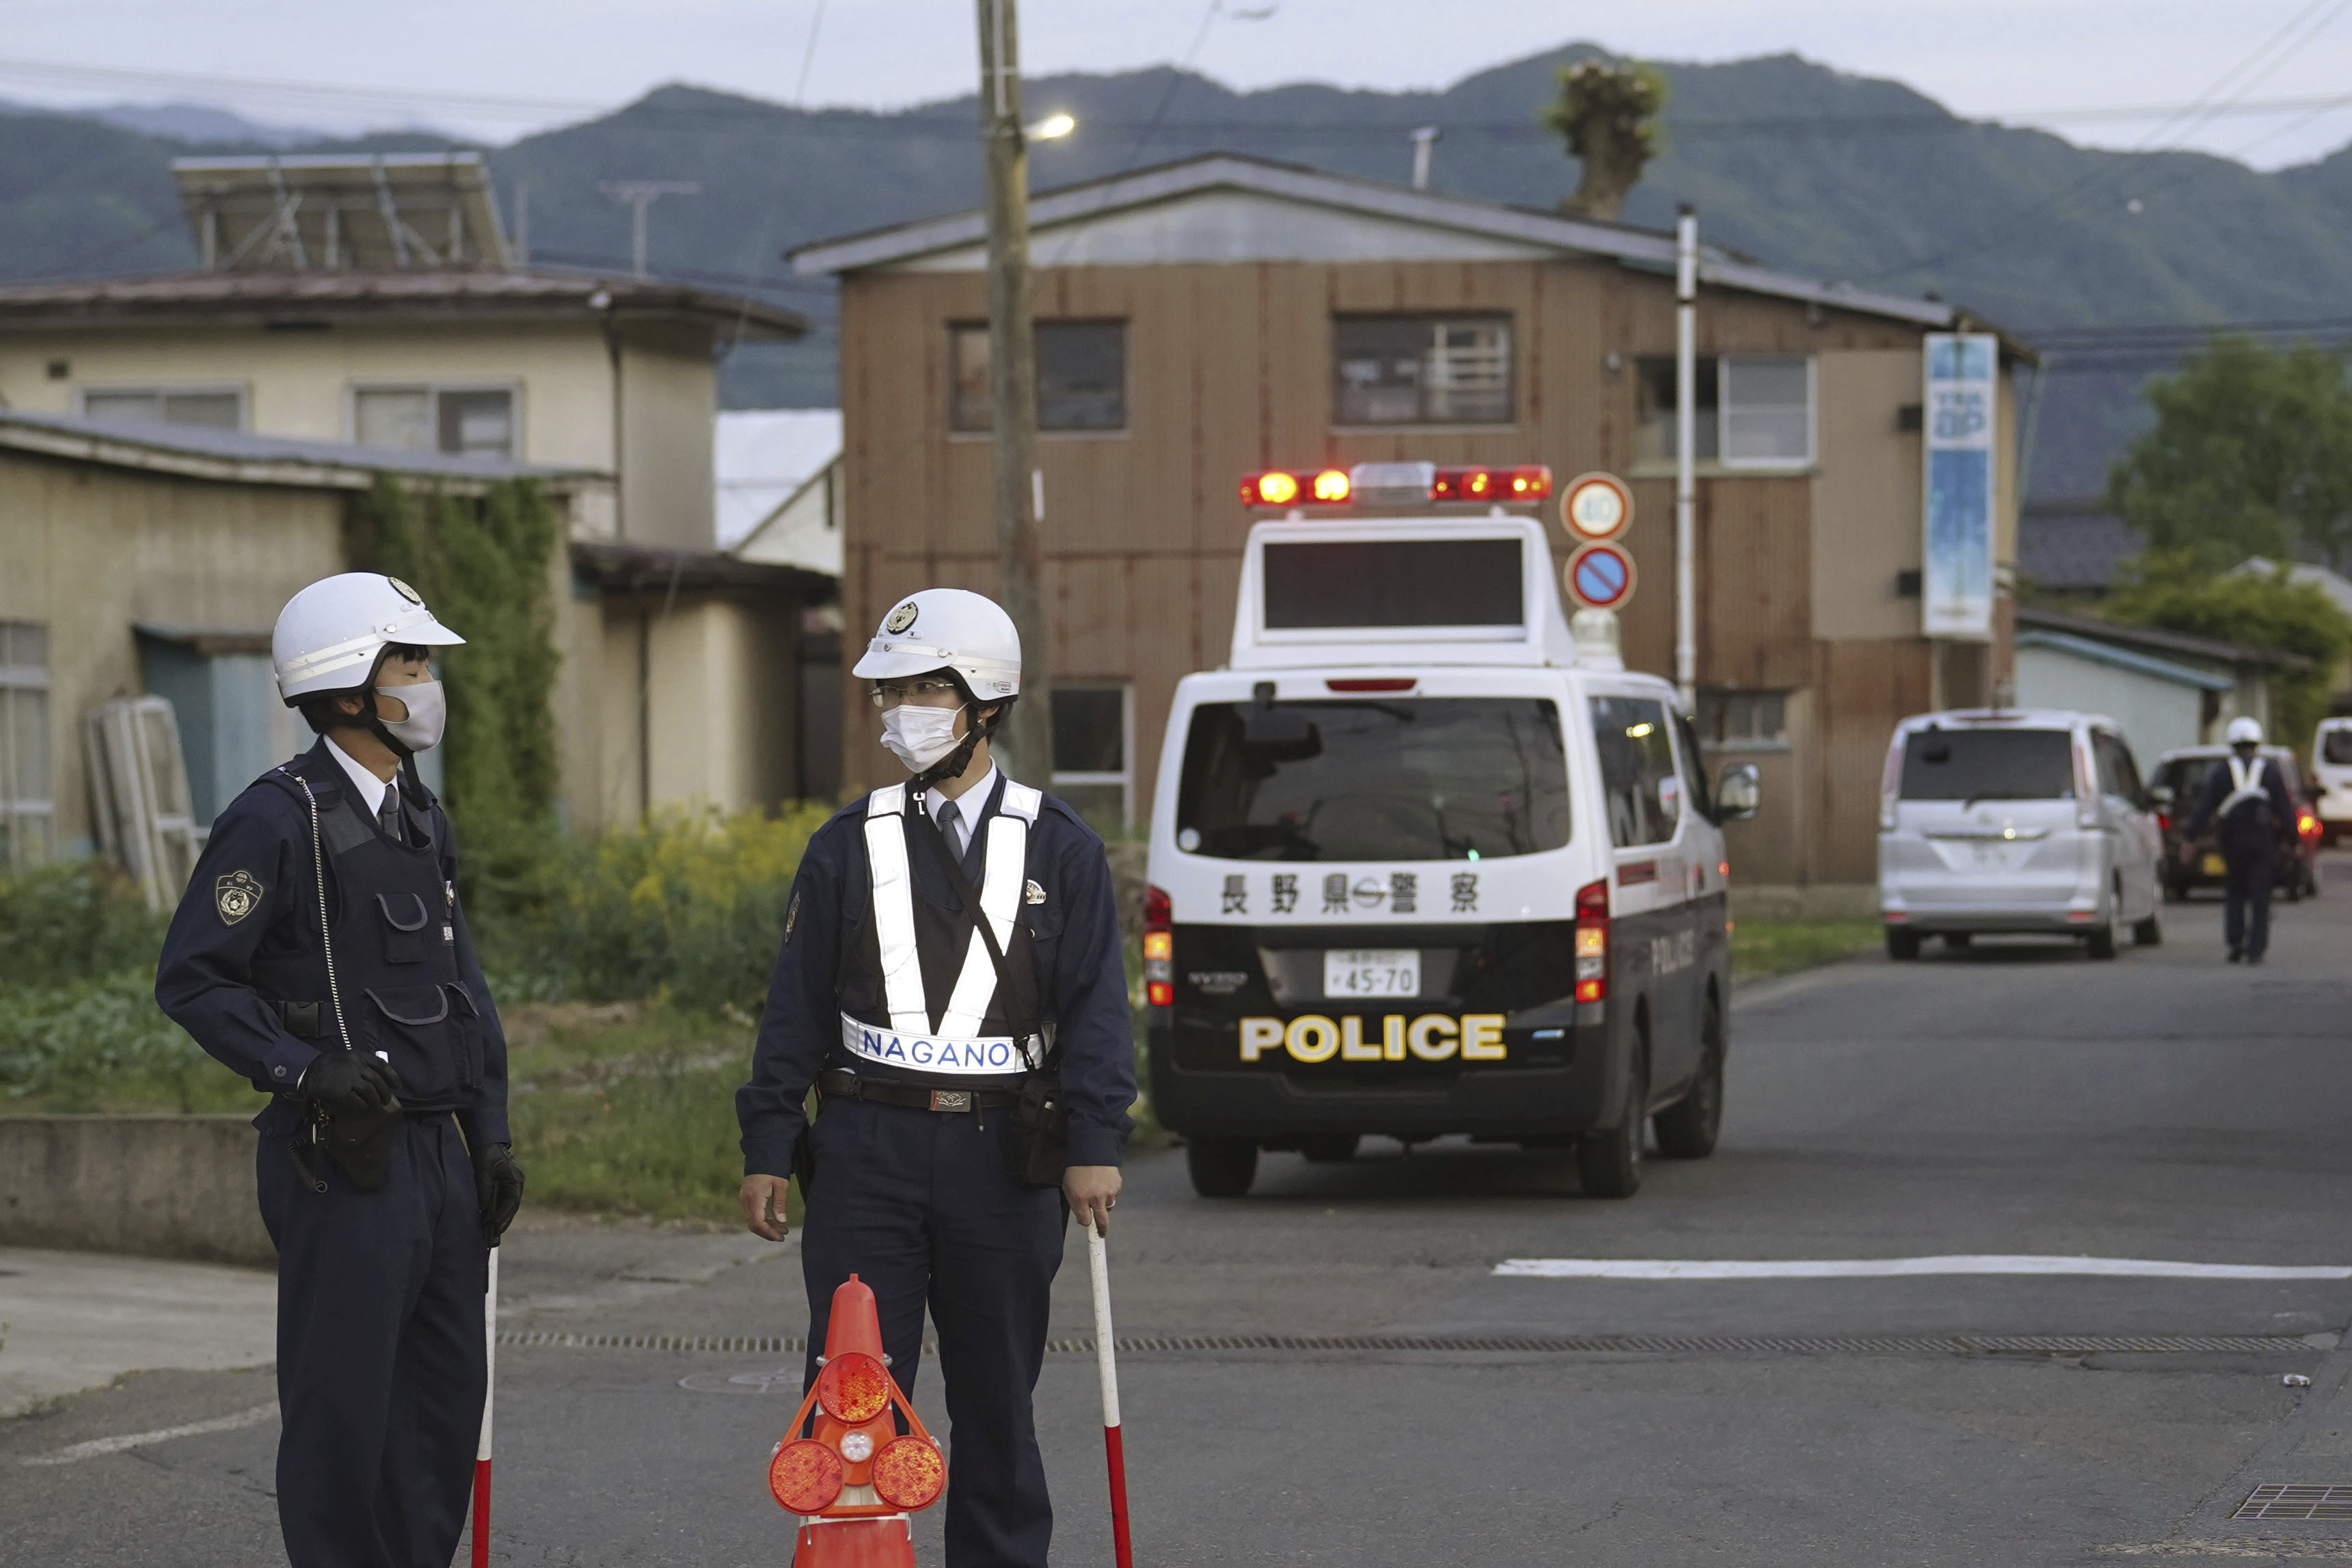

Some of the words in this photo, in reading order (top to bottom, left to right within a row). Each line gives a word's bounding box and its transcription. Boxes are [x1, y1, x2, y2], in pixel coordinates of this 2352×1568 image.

[1221, 872, 1478, 914] 長野県警察
[1346, 968, 1412, 992] 45-70
[864, 1029, 1010, 1067] NAGANO
[1239, 1014, 1507, 1062] POLICE
